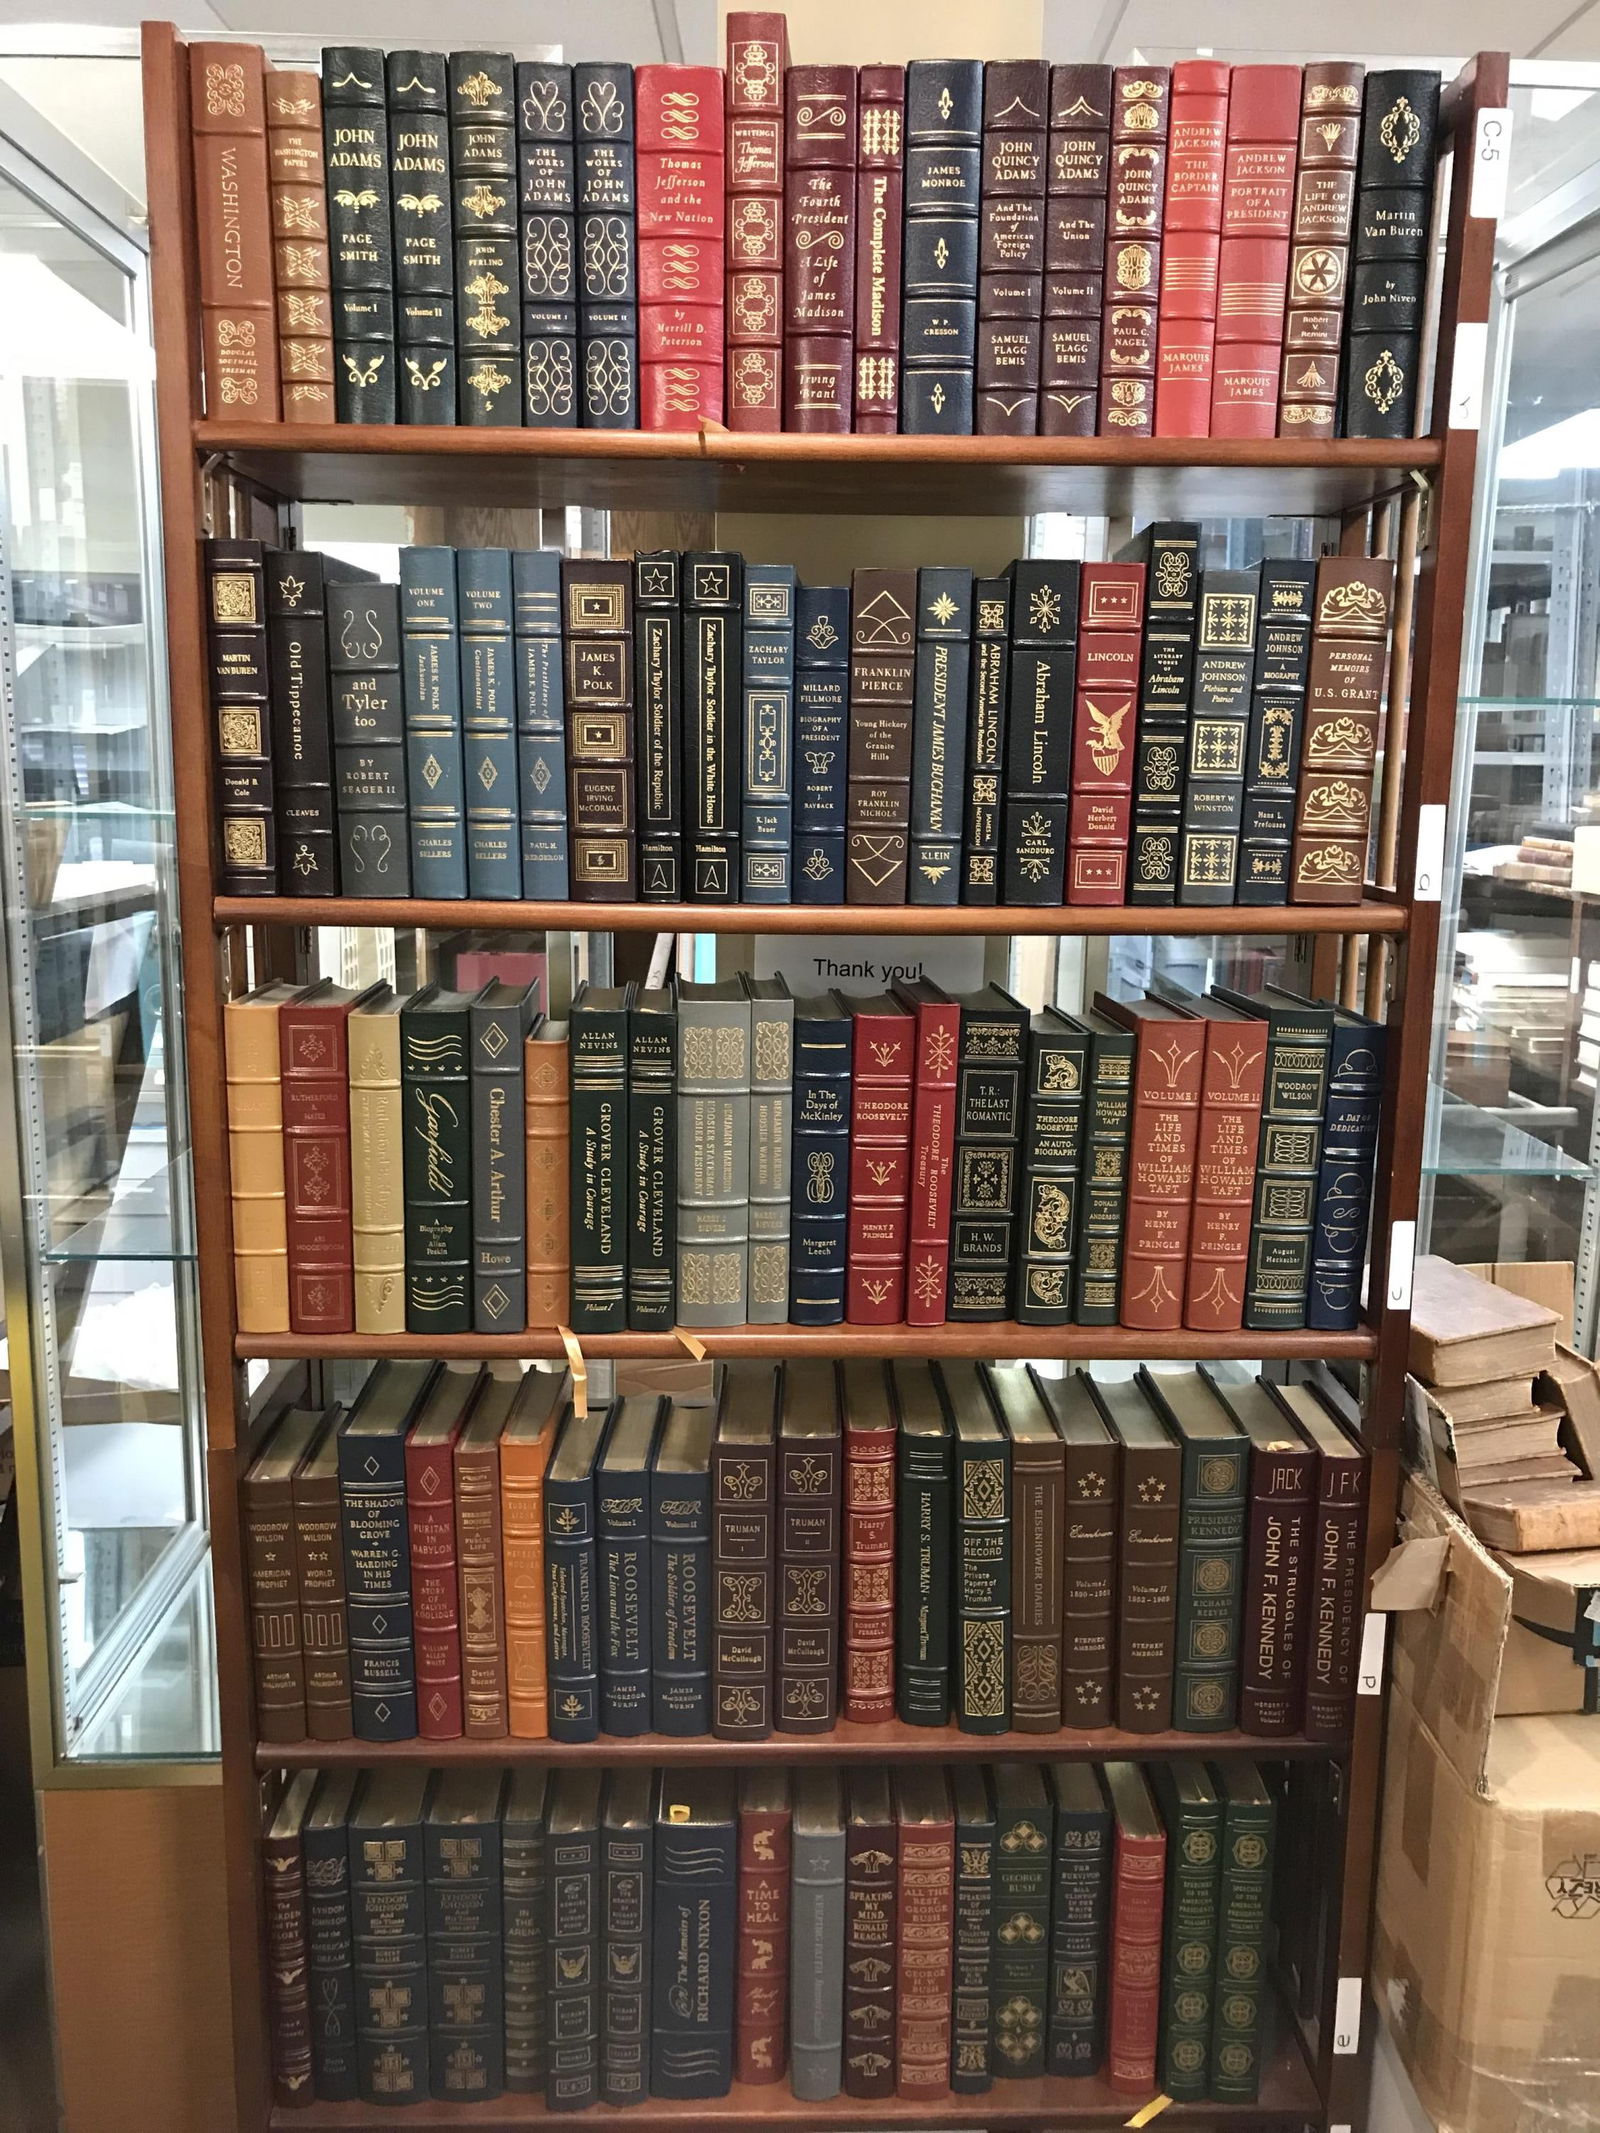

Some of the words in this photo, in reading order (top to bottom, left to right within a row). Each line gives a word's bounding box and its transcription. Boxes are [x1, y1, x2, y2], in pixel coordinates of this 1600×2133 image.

[333, 129, 375, 147] JOHN
[397, 134, 439, 152] JOHN
[468, 134, 496, 146] JOHN
[1481, 120, 1502, 161] C-5
[464, 148, 502, 158] ADAMS
[535, 149, 556, 157] THE
[738, 141, 772, 155] Thomas
[1000, 142, 1033, 155] JOHN
[330, 154, 382, 169] ADAMS
[528, 159, 565, 167] WORKS
[661, 158, 701, 170] Thomas
[737, 155, 775, 173] Jefferson
[992, 155, 1040, 168] QUINCY
[1237, 154, 1286, 164] ANDREW
[394, 158, 446, 172] ADAMS
[1236, 165, 1285, 176] JACKSON
[928, 167, 961, 176] JAMES
[995, 168, 1036, 180] ADAMS
[528, 179, 566, 191] JOHN
[655, 176, 706, 189] Jefferson
[807, 179, 832, 191] The
[922, 178, 966, 188] MONROE
[524, 192, 571, 203] ADAMS
[872, 176, 887, 208] The
[1230, 187, 1287, 198] PORTRAIT
[660, 195, 680, 205] and
[683, 194, 702, 204] the
[799, 196, 841, 207] Fourth
[221, 148, 243, 289] WASHINGTON
[649, 213, 673, 223] New
[676, 214, 714, 224] Nation
[792, 212, 848, 225] President
[1226, 209, 1288, 220] PRESIDENT
[1375, 210, 1416, 222] Martin
[993, 232, 1035, 241] American
[1365, 225, 1388, 237] Van
[1390, 225, 1424, 237] Buren
[342, 234, 373, 244] PAGE
[405, 238, 436, 248] PAGE
[871, 213, 887, 275] Complete
[340, 250, 378, 262] SMITH
[403, 254, 441, 266] SMITH
[813, 256, 838, 270] Life
[1362, 292, 1387, 305] John
[1389, 293, 1417, 303] Niven
[343, 303, 372, 313] Volume
[793, 305, 844, 318] Madison
[870, 277, 886, 336] Madison
[405, 308, 433, 317] Volume
[1113, 327, 1136, 337] PAUL
[991, 334, 1031, 344] SAMUEL
[1114, 337, 1148, 347] NAGEL
[994, 345, 1027, 354] FLAGG
[996, 356, 1025, 366] BEMIS
[466, 590, 501, 599] VOLUME
[473, 601, 492, 609] TWO
[1268, 632, 1303, 642] ANDREW
[706, 623, 717, 663] Zachary
[749, 646, 788, 655] ZACHARY
[1265, 644, 1303, 654] JOHNSON
[288, 642, 302, 671] Old
[580, 652, 616, 663] JAMES
[752, 655, 785, 665] TAYLOR
[1087, 652, 1134, 662] LINCOLN
[1329, 653, 1373, 661] PERSONAL
[1202, 660, 1246, 670] ANDREW
[1330, 664, 1370, 673] MEMOIRS
[854, 668, 911, 678] FRANKLIN
[989, 644, 1002, 706] ABRAHAM
[353, 679, 376, 691] and
[583, 680, 613, 690] POLK
[707, 665, 716, 696] Taylor
[861, 680, 903, 691] PIERCE
[932, 646, 948, 715] PRESIDENT
[803, 684, 841, 694] MILLARD
[1035, 660, 1051, 724] Abraham
[1314, 688, 1338, 698] U.S.
[1342, 689, 1379, 699] GRANT
[342, 696, 388, 712] Tyler
[800, 694, 842, 704] FILLMORE
[290, 672, 303, 761] Tippecanoe
[354, 716, 376, 727] too
[931, 717, 945, 760] JAMES
[986, 708, 998, 764] LINCOLN
[1032, 730, 1049, 785] Lincoln
[346, 772, 389, 781] ROBERT
[928, 762, 945, 832] BUCHANAN
[706, 790, 714, 824] House
[1194, 804, 1234, 813] WINSTON
[921, 851, 950, 861] KLEIN
[813, 958, 874, 978] Thank
[881, 962, 923, 982] you!
[582, 1031, 615, 1040] ALLAN
[580, 1041, 618, 1050] NEVINS
[1277, 1082, 1318, 1091] WOODROW
[1144, 1091, 1191, 1101] VOLUME
[1282, 1091, 1312, 1101] WILSON
[806, 1099, 828, 1111] Days
[489, 1087, 505, 1145] Chester
[800, 1111, 843, 1122] McKinley
[856, 1112, 908, 1121] ROOSEVELT
[966, 1110, 1011, 1121] ROMANTIC
[600, 1102, 612, 1162] GROVER
[932, 1104, 942, 1162] THEODORE
[1155, 1122, 1182, 1133] LIFE
[653, 1106, 664, 1165] GROVER
[415, 1088, 459, 1197] Garfield
[1148, 1143, 1185, 1153] TIMES
[1034, 1148, 1077, 1157] BIOGRAPHY
[1138, 1163, 1191, 1174] WILLIAM
[1138, 1173, 1190, 1183] HOWARD
[1150, 1184, 1180, 1194] TAFT
[490, 1170, 506, 1223] Arthur
[928, 1165, 939, 1229] ROOSEVELT
[601, 1167, 612, 1255] CLEVELAND
[653, 1169, 663, 1257] CLEVELAND
[963, 1244, 1002, 1253] BRANDS
[481, 1253, 511, 1264] Howe
[1270, 1468, 1302, 1494] JACK
[364, 1499, 404, 1508] SHADOW
[920, 1492, 931, 1532] HARRY
[350, 1519, 400, 1530] BLOOMING
[790, 1518, 826, 1527] TRUMAN
[360, 1529, 390, 1539] GROVE
[725, 1524, 760, 1534] TRUMAN
[1034, 1509, 1044, 1580] EISENHOWER
[1266, 1516, 1282, 1568] JOHN
[964, 1546, 1002, 1556] RECORD
[355, 1560, 398, 1569] HARDING
[921, 1548, 931, 1595] TRUMAN
[624, 1552, 639, 1660] ROOSEVELT
[682, 1552, 696, 1662] ROOSEVELT
[1034, 1583, 1043, 1626] DIARIES
[1284, 1553, 1301, 1652] STRUGGLES
[1258, 1593, 1278, 1680] KENNEDY
[1316, 1597, 1337, 1684] KENNEDY
[747, 1890, 779, 1900] TIME
[849, 1892, 893, 1901] SPEAKING
[746, 1912, 779, 1922] HEAL
[859, 1910, 885, 1920] MIND
[698, 1899, 710, 1949] NIXON
[697, 1952, 709, 2023] RICHARD
